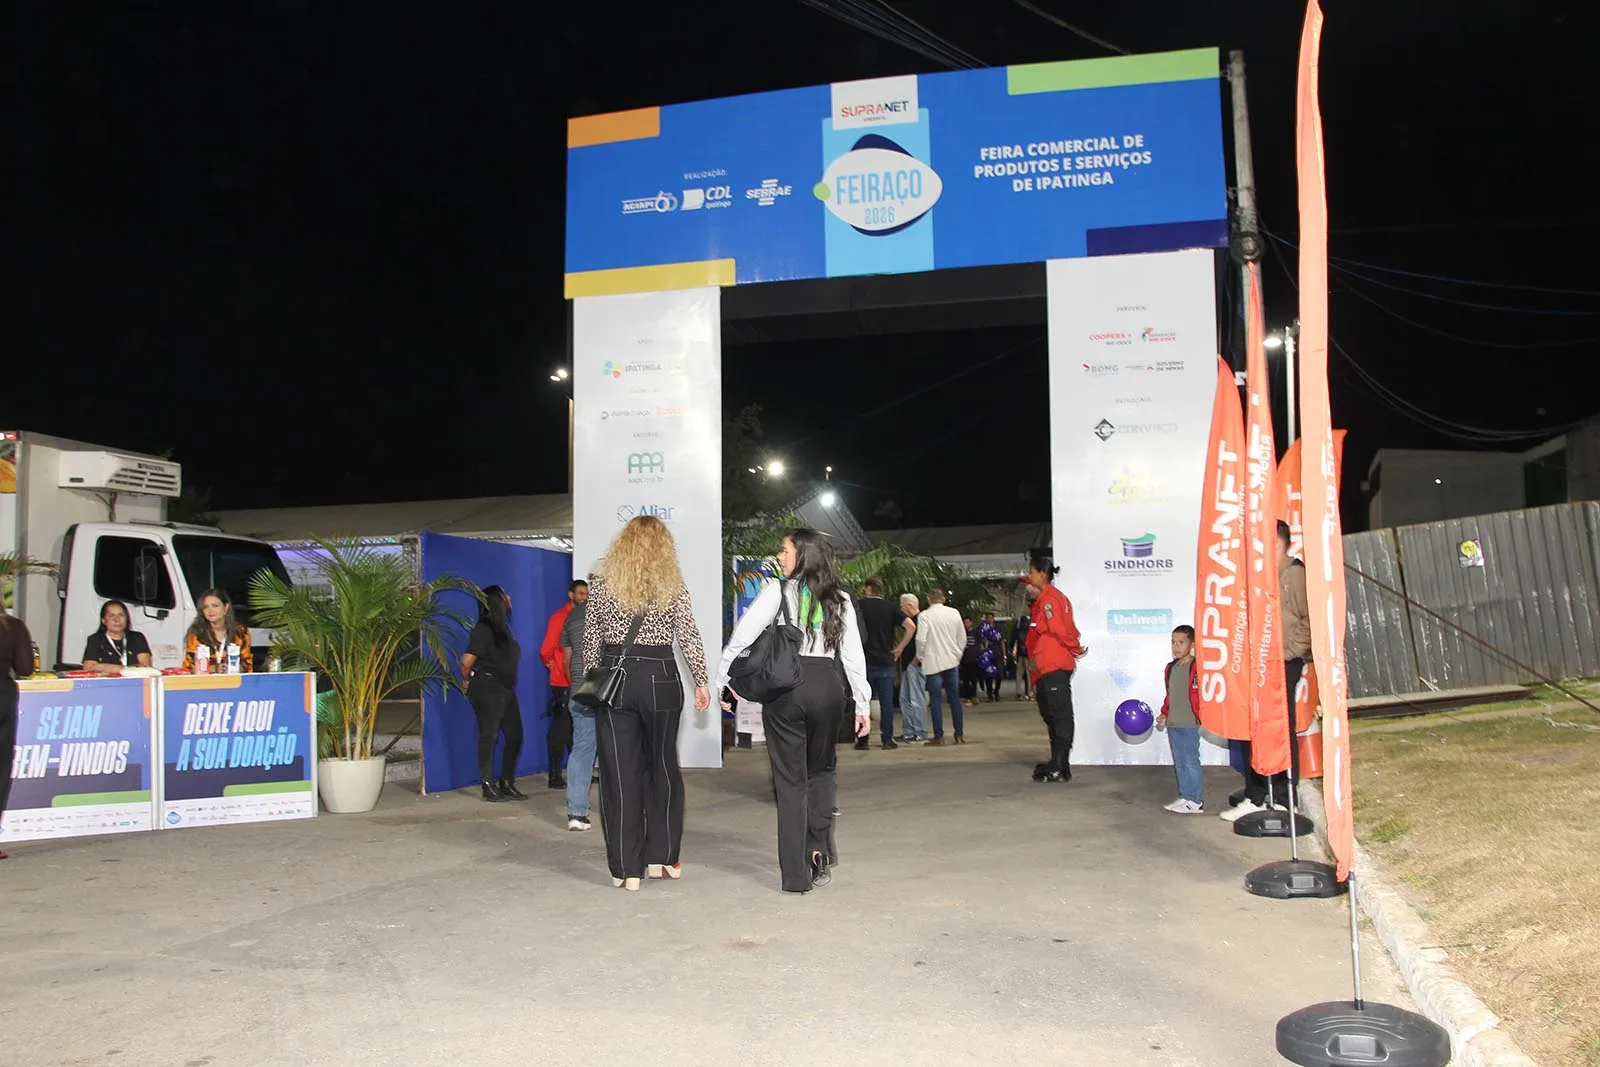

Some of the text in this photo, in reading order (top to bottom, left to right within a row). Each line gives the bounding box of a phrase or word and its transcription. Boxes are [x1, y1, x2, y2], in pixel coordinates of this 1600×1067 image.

[841, 101, 909, 118] SUPRANET
[980, 134, 1144, 161] FEIRA COMERCIAL DE
[974, 151, 1152, 178] PRODUTOS E SERVIÇOS
[706, 186, 732, 200] CDL
[745, 185, 793, 200] SEBRAE
[836, 169, 922, 206] FEIRAÇO
[1012, 171, 1114, 193] DE IPATINGA
[864, 206, 895, 225] 2026
[1104, 558, 1174, 570] SINDHORB
[1113, 613, 1168, 625] Unimed
[36, 704, 103, 740] SEJAM
[182, 700, 276, 735] DEIXE AQUI
[176, 726, 297, 771] A SUA DOAÇÃO
